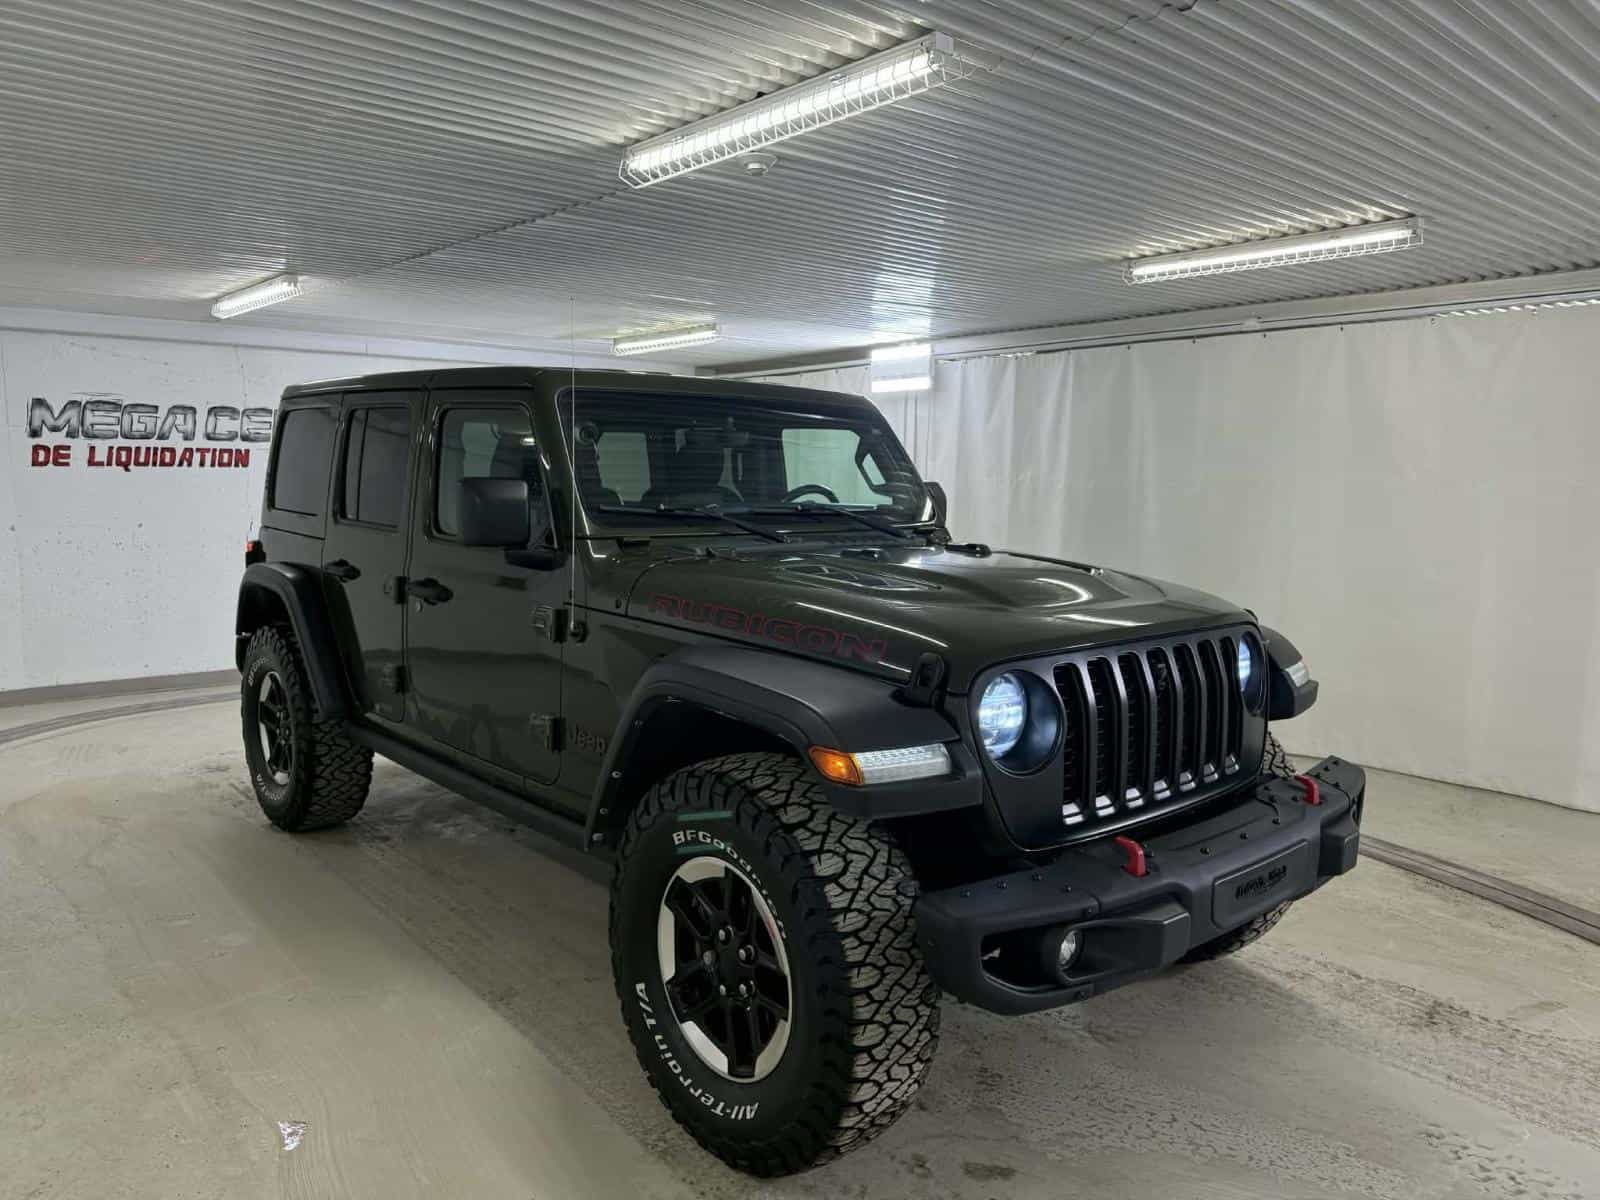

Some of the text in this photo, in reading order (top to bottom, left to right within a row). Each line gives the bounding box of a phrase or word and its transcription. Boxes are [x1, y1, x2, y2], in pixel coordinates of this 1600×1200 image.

[205, 404, 277, 442] CE
[31, 444, 250, 472] DE LIQUIDATION
[650, 595, 888, 662] RUBICON
[634, 981, 657, 1030] T/A
